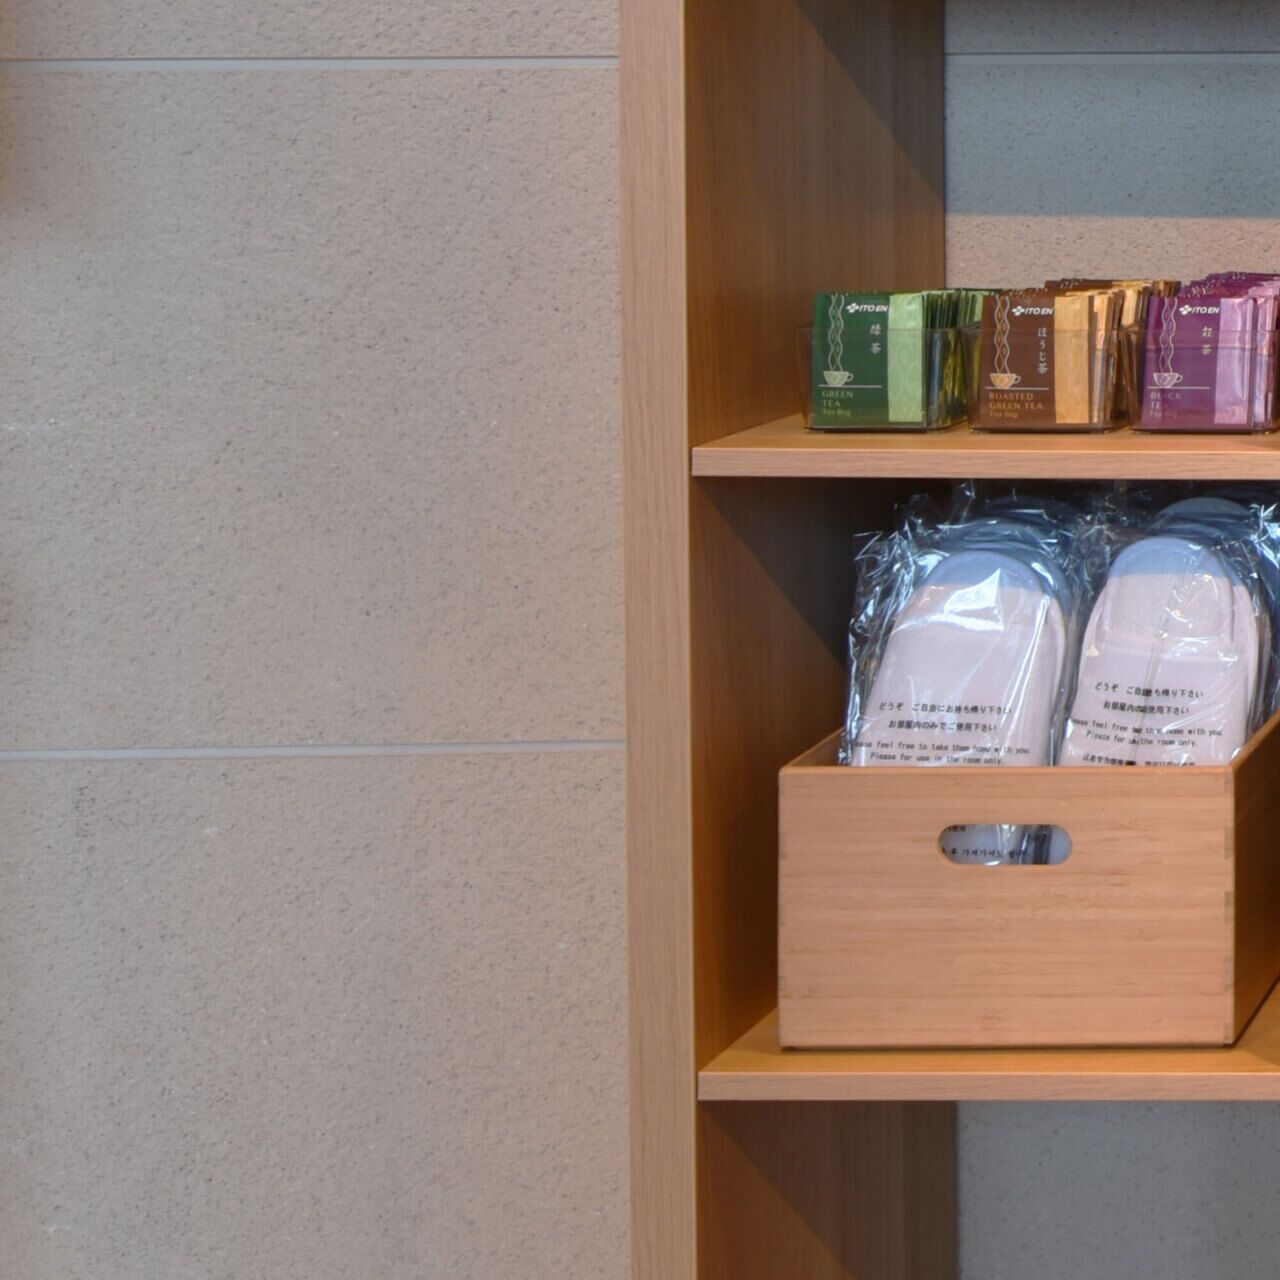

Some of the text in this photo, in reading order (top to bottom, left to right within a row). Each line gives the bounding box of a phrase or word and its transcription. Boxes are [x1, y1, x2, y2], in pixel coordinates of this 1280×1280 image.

[859, 304, 889, 312] ITO EN
[1024, 307, 1054, 315] ITO EN
[1191, 306, 1220, 314] ITO EN
[1037, 327, 1049, 375] ほうじ茶
[822, 390, 853, 398] GREEN
[988, 392, 1034, 400] ROASTED
[822, 399, 841, 407] TEA
[988, 401, 1044, 410] GREEN TEA
[1094, 681, 1119, 693] どうぞ
[879, 702, 904, 711] どうぞ
[876, 740, 948, 752] feel free to take
[870, 753, 943, 763] Please for use in
